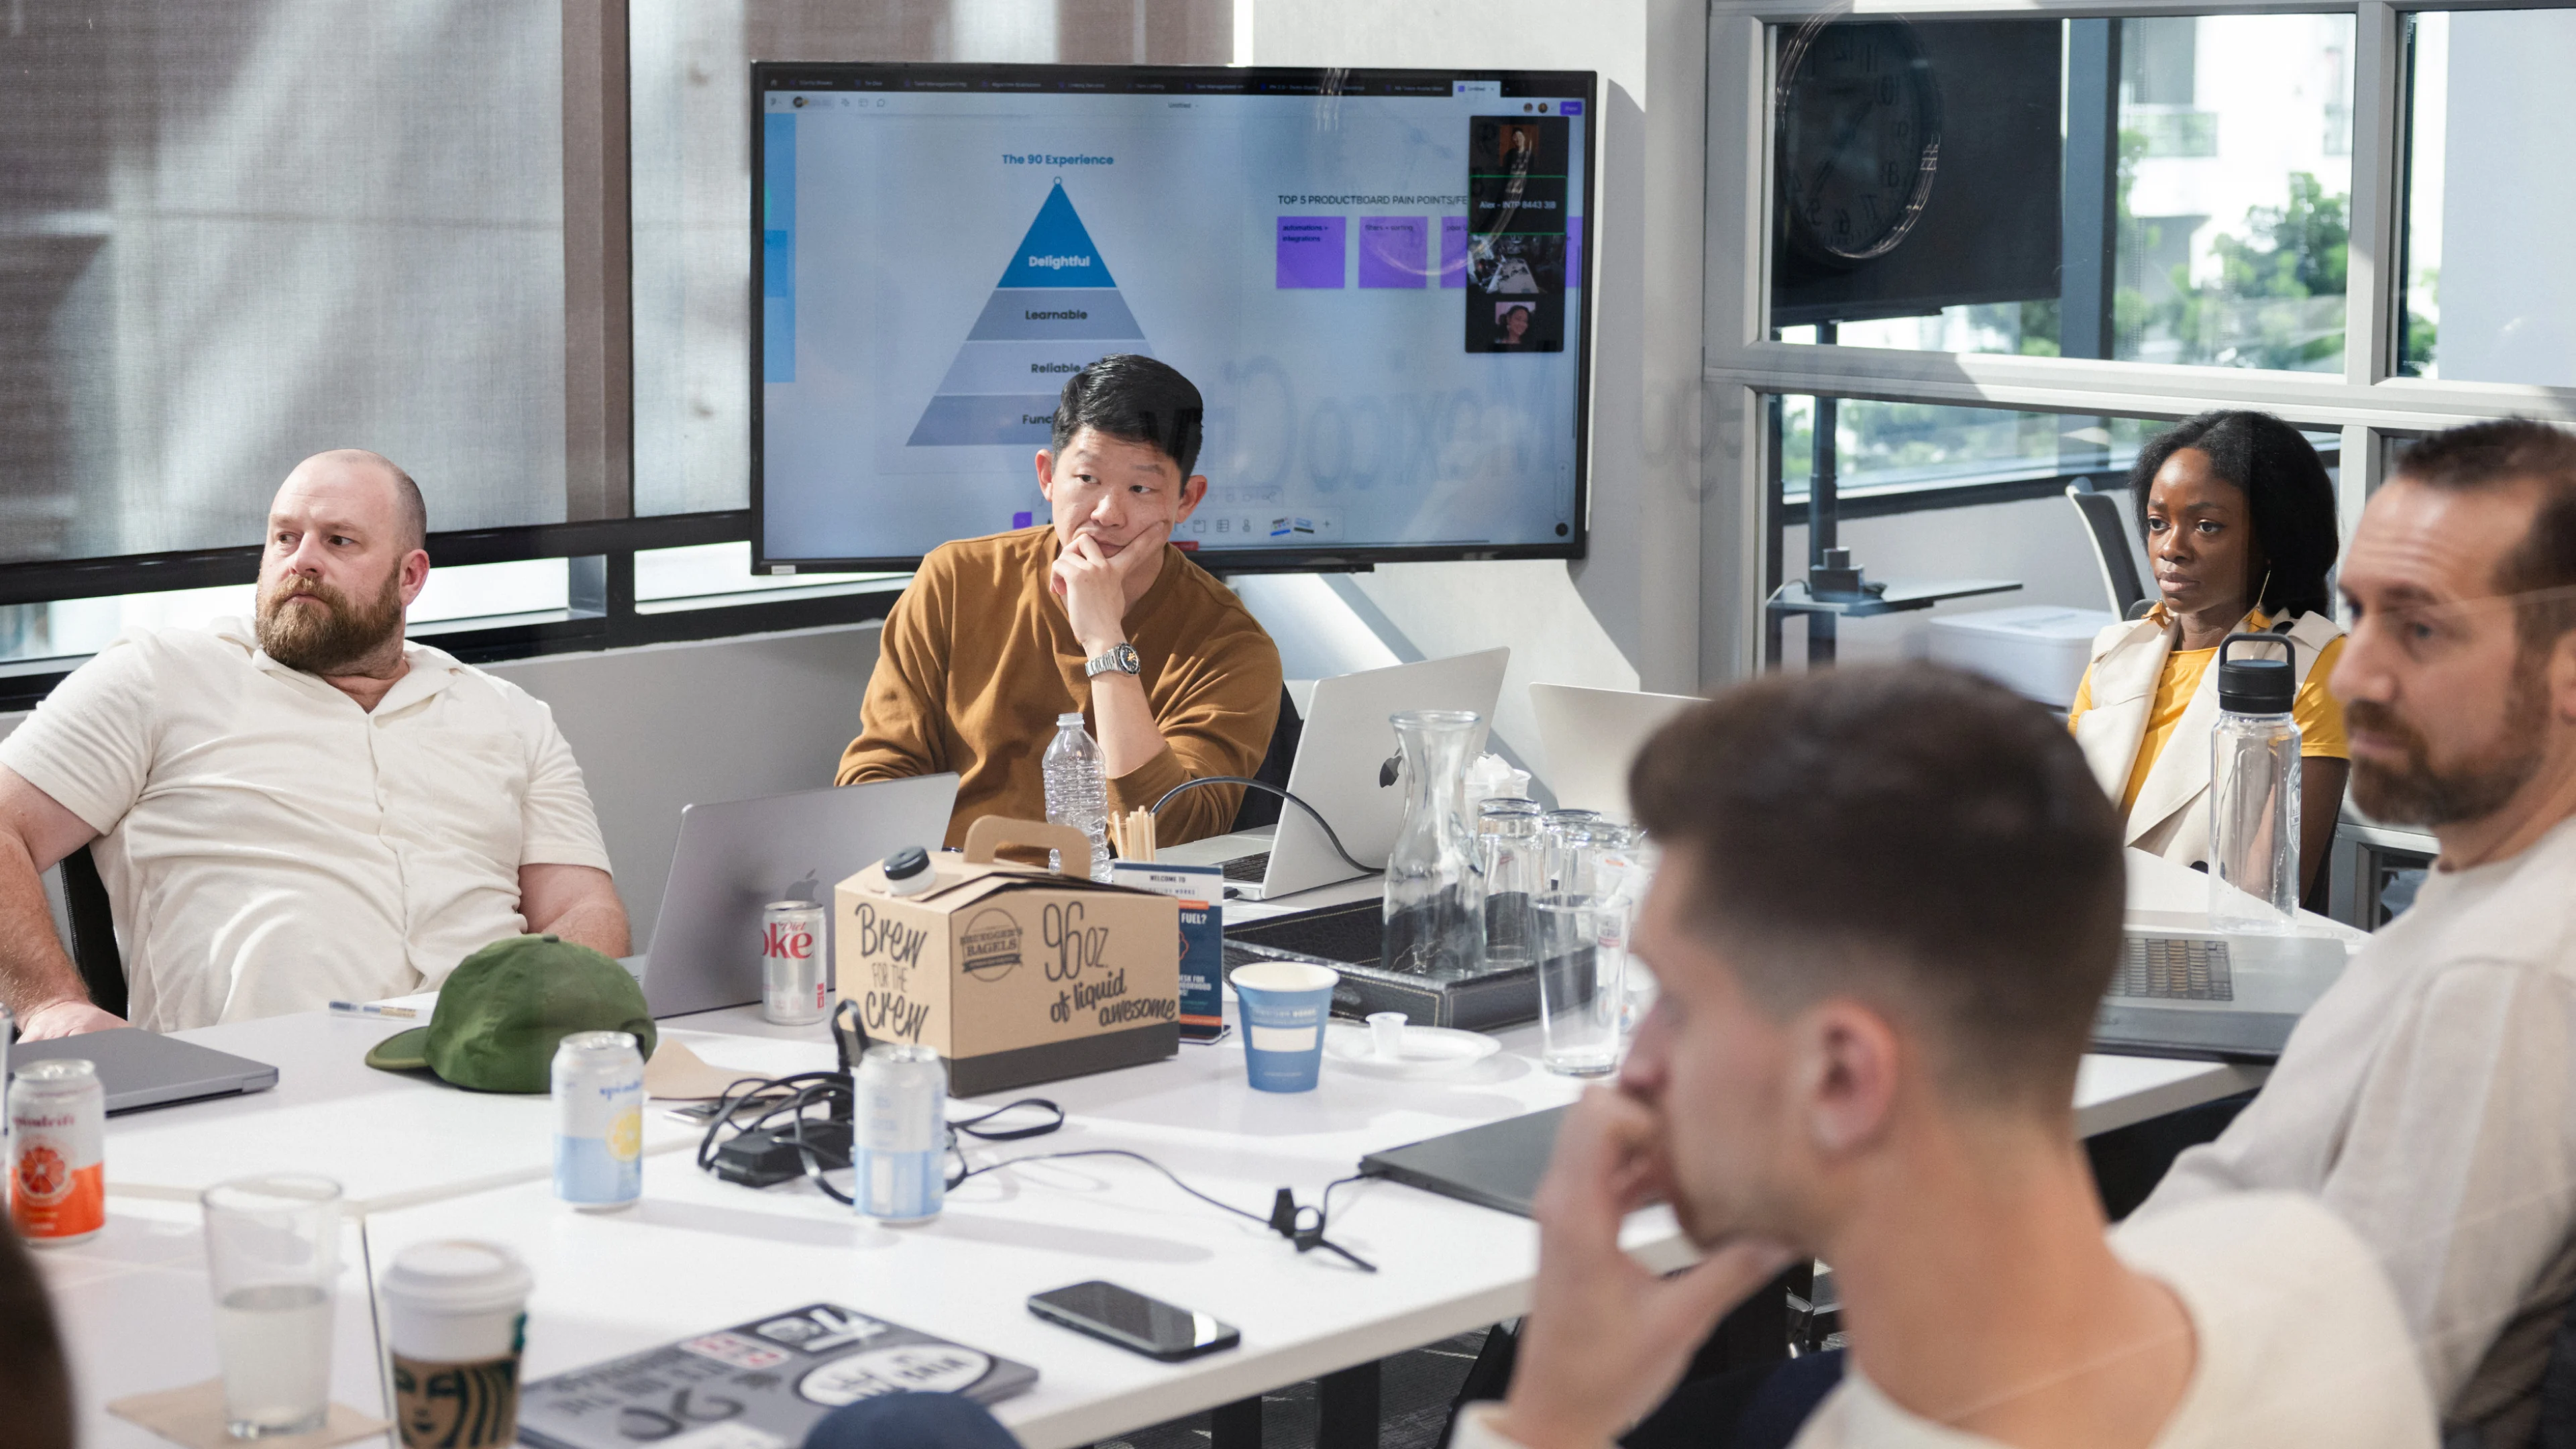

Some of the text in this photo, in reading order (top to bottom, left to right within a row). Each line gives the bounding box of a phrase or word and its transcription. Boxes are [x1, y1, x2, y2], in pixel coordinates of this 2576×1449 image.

[1002, 154, 1114, 167] The 90 Experience
[1278, 195, 1298, 205] TOP
[1300, 195, 1306, 205] 5
[1308, 195, 1391, 205] PRODUCTBOARD
[1393, 196, 1415, 205] PAIN
[1283, 235, 1320, 243] integrations
[1028, 254, 1090, 270] Delightful
[1024, 310, 1088, 321] Learnable
[1031, 363, 1081, 374] Reliable
[1150, 875, 1177, 883] WELCOME
[1181, 912, 1208, 924] FUEL?
[778, 921, 807, 931] Diet
[855, 903, 928, 969] Brew
[1043, 901, 1084, 982] 96
[967, 938, 1018, 957] BAGELS
[871, 962, 908, 993] FOR THE
[1193, 975, 1205, 983] FOR
[1050, 967, 1128, 1023] of liquid
[1099, 998, 1176, 1027] awesome
